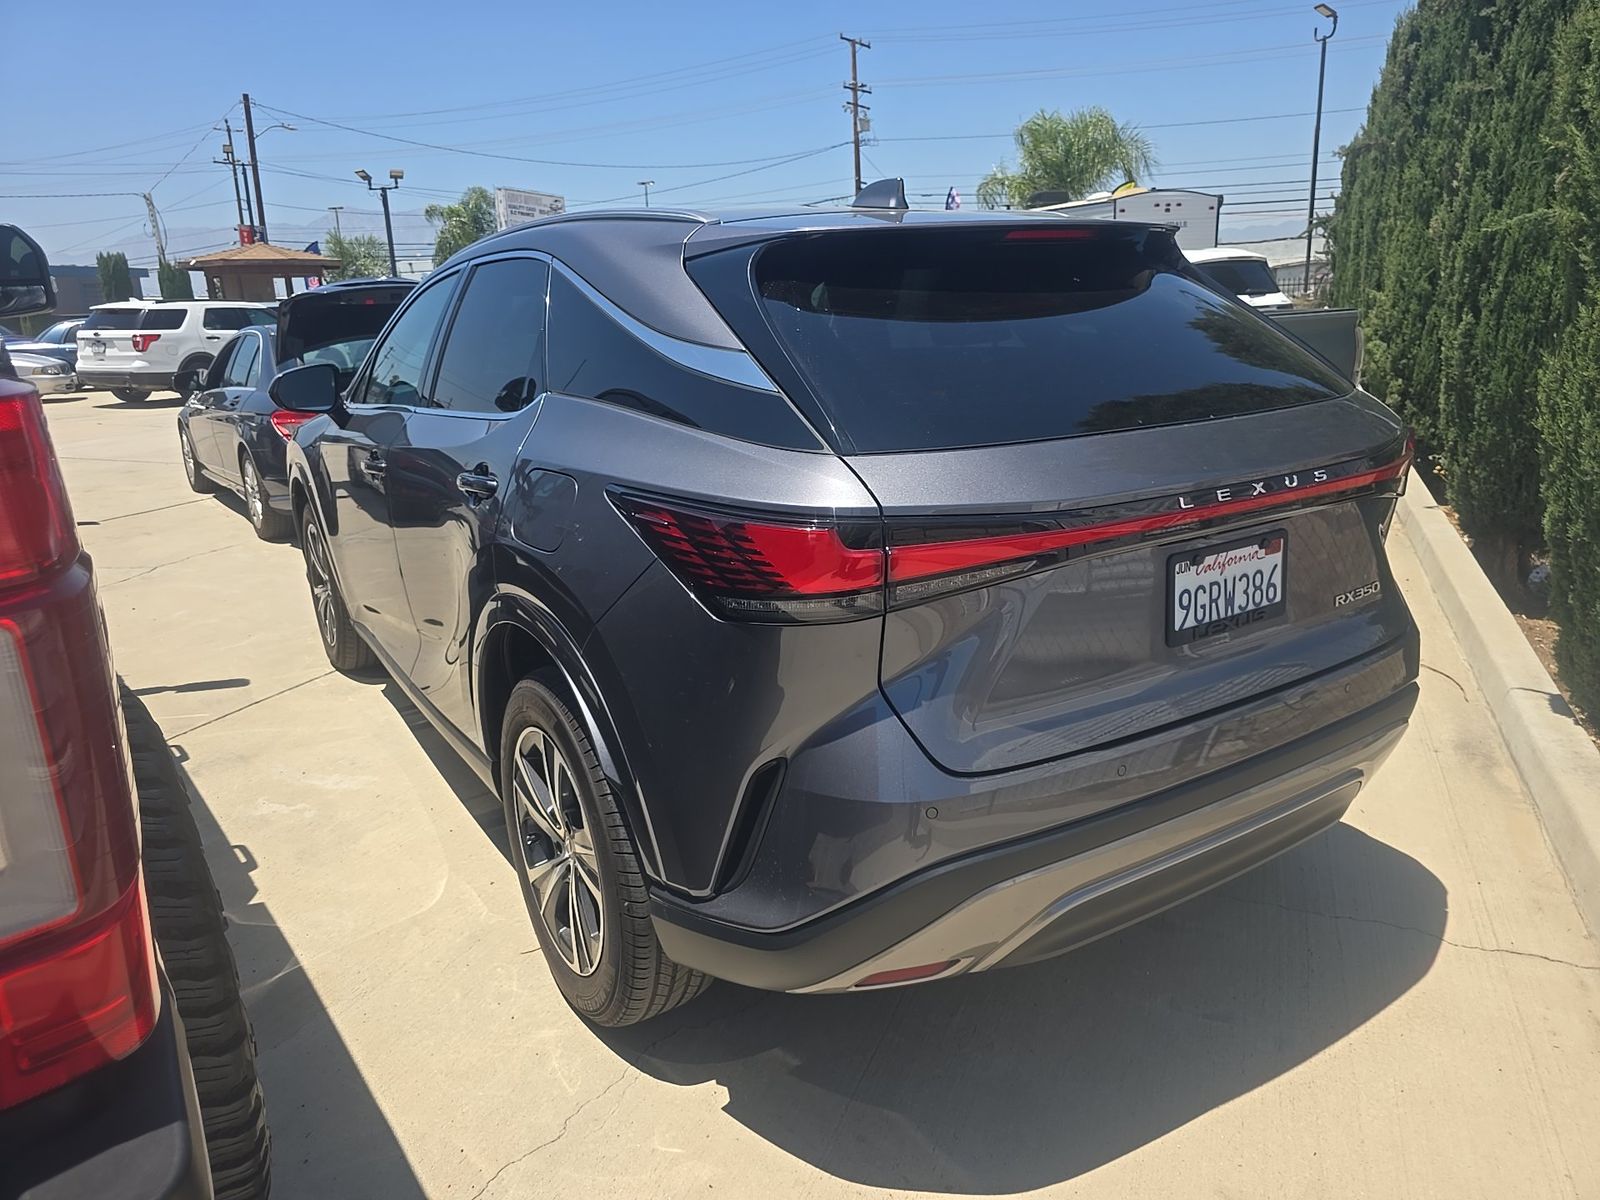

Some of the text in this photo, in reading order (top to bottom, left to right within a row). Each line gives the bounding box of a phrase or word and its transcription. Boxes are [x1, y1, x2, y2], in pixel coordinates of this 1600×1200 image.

[1179, 469, 1328, 509] LEXUS
[1176, 548, 1266, 576] JUN California
[1178, 563, 1279, 630] 9GRW386
[1334, 581, 1380, 607] RX350
